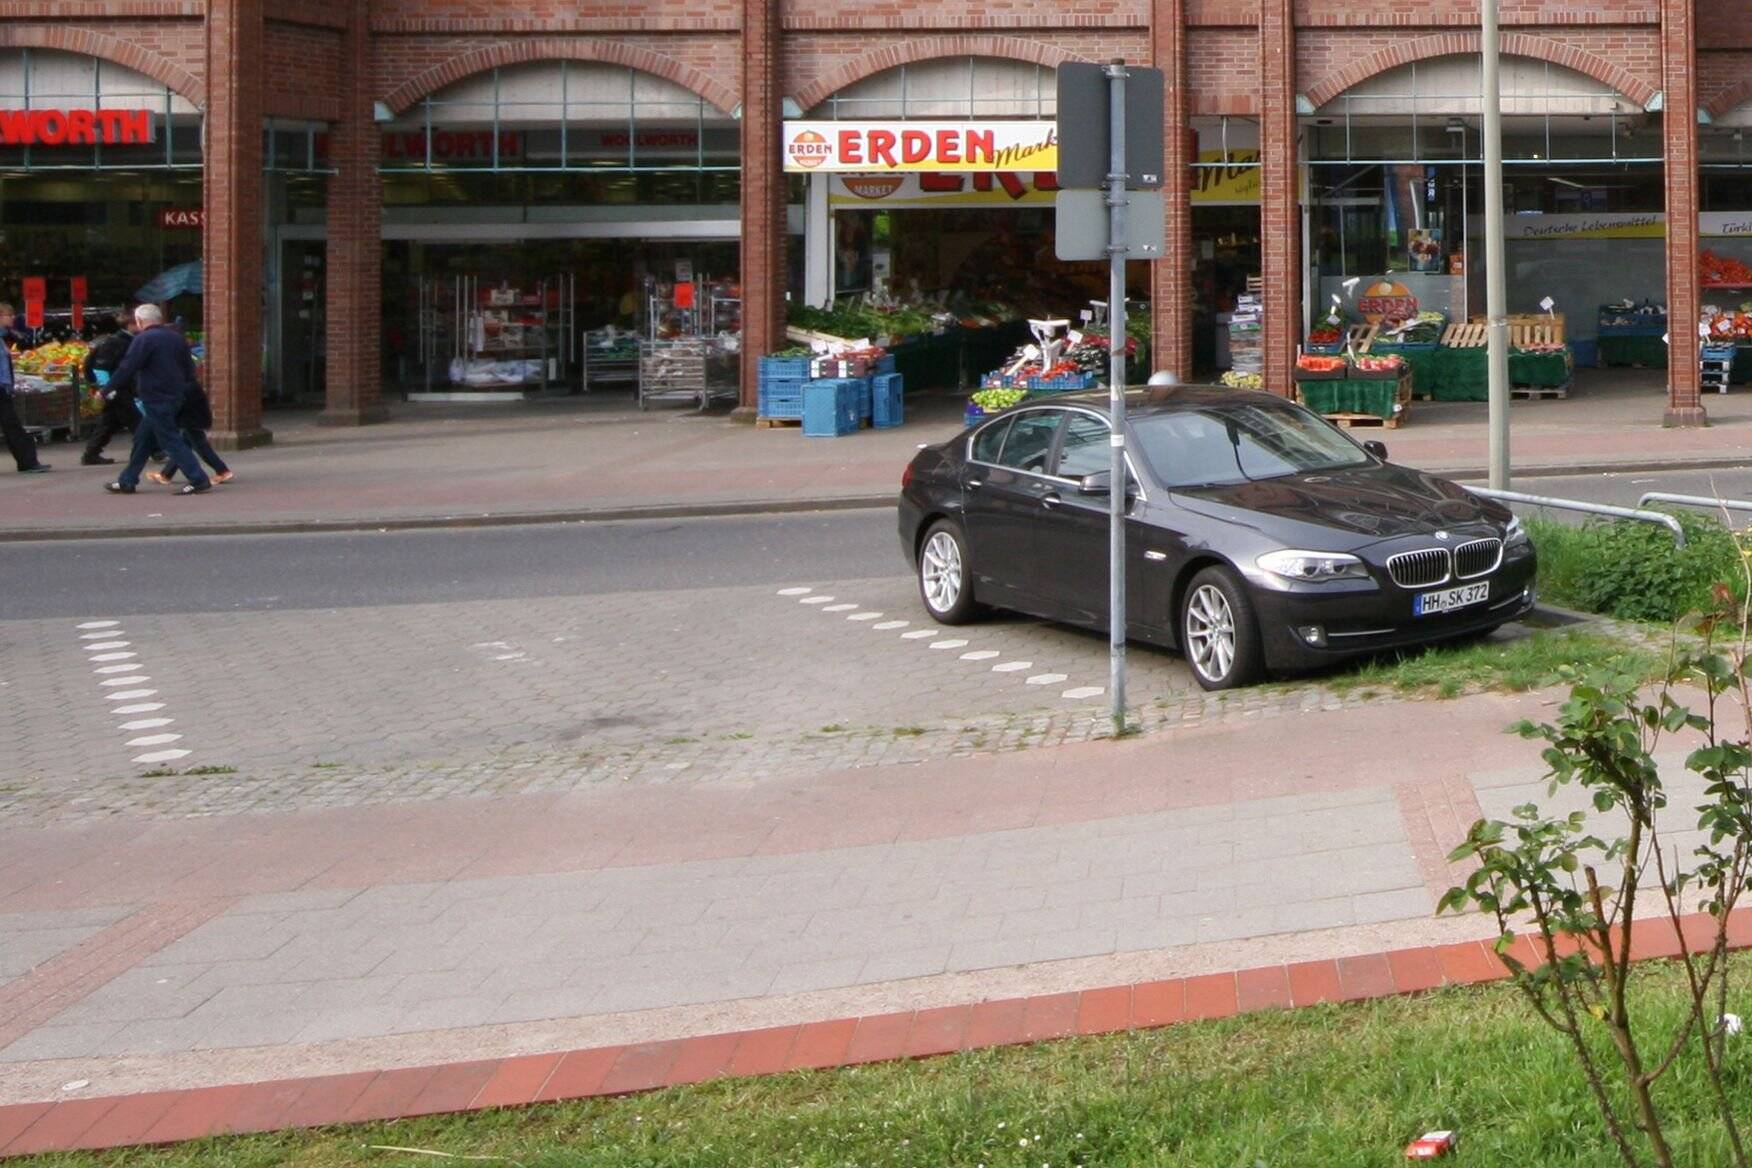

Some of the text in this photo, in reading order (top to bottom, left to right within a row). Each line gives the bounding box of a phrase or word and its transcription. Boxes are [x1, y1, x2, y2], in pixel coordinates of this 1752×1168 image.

[788, 143, 833, 155] ERDEN
[838, 128, 1057, 168] ERDEN Mark
[1422, 584, 1488, 611] HH SK 372
